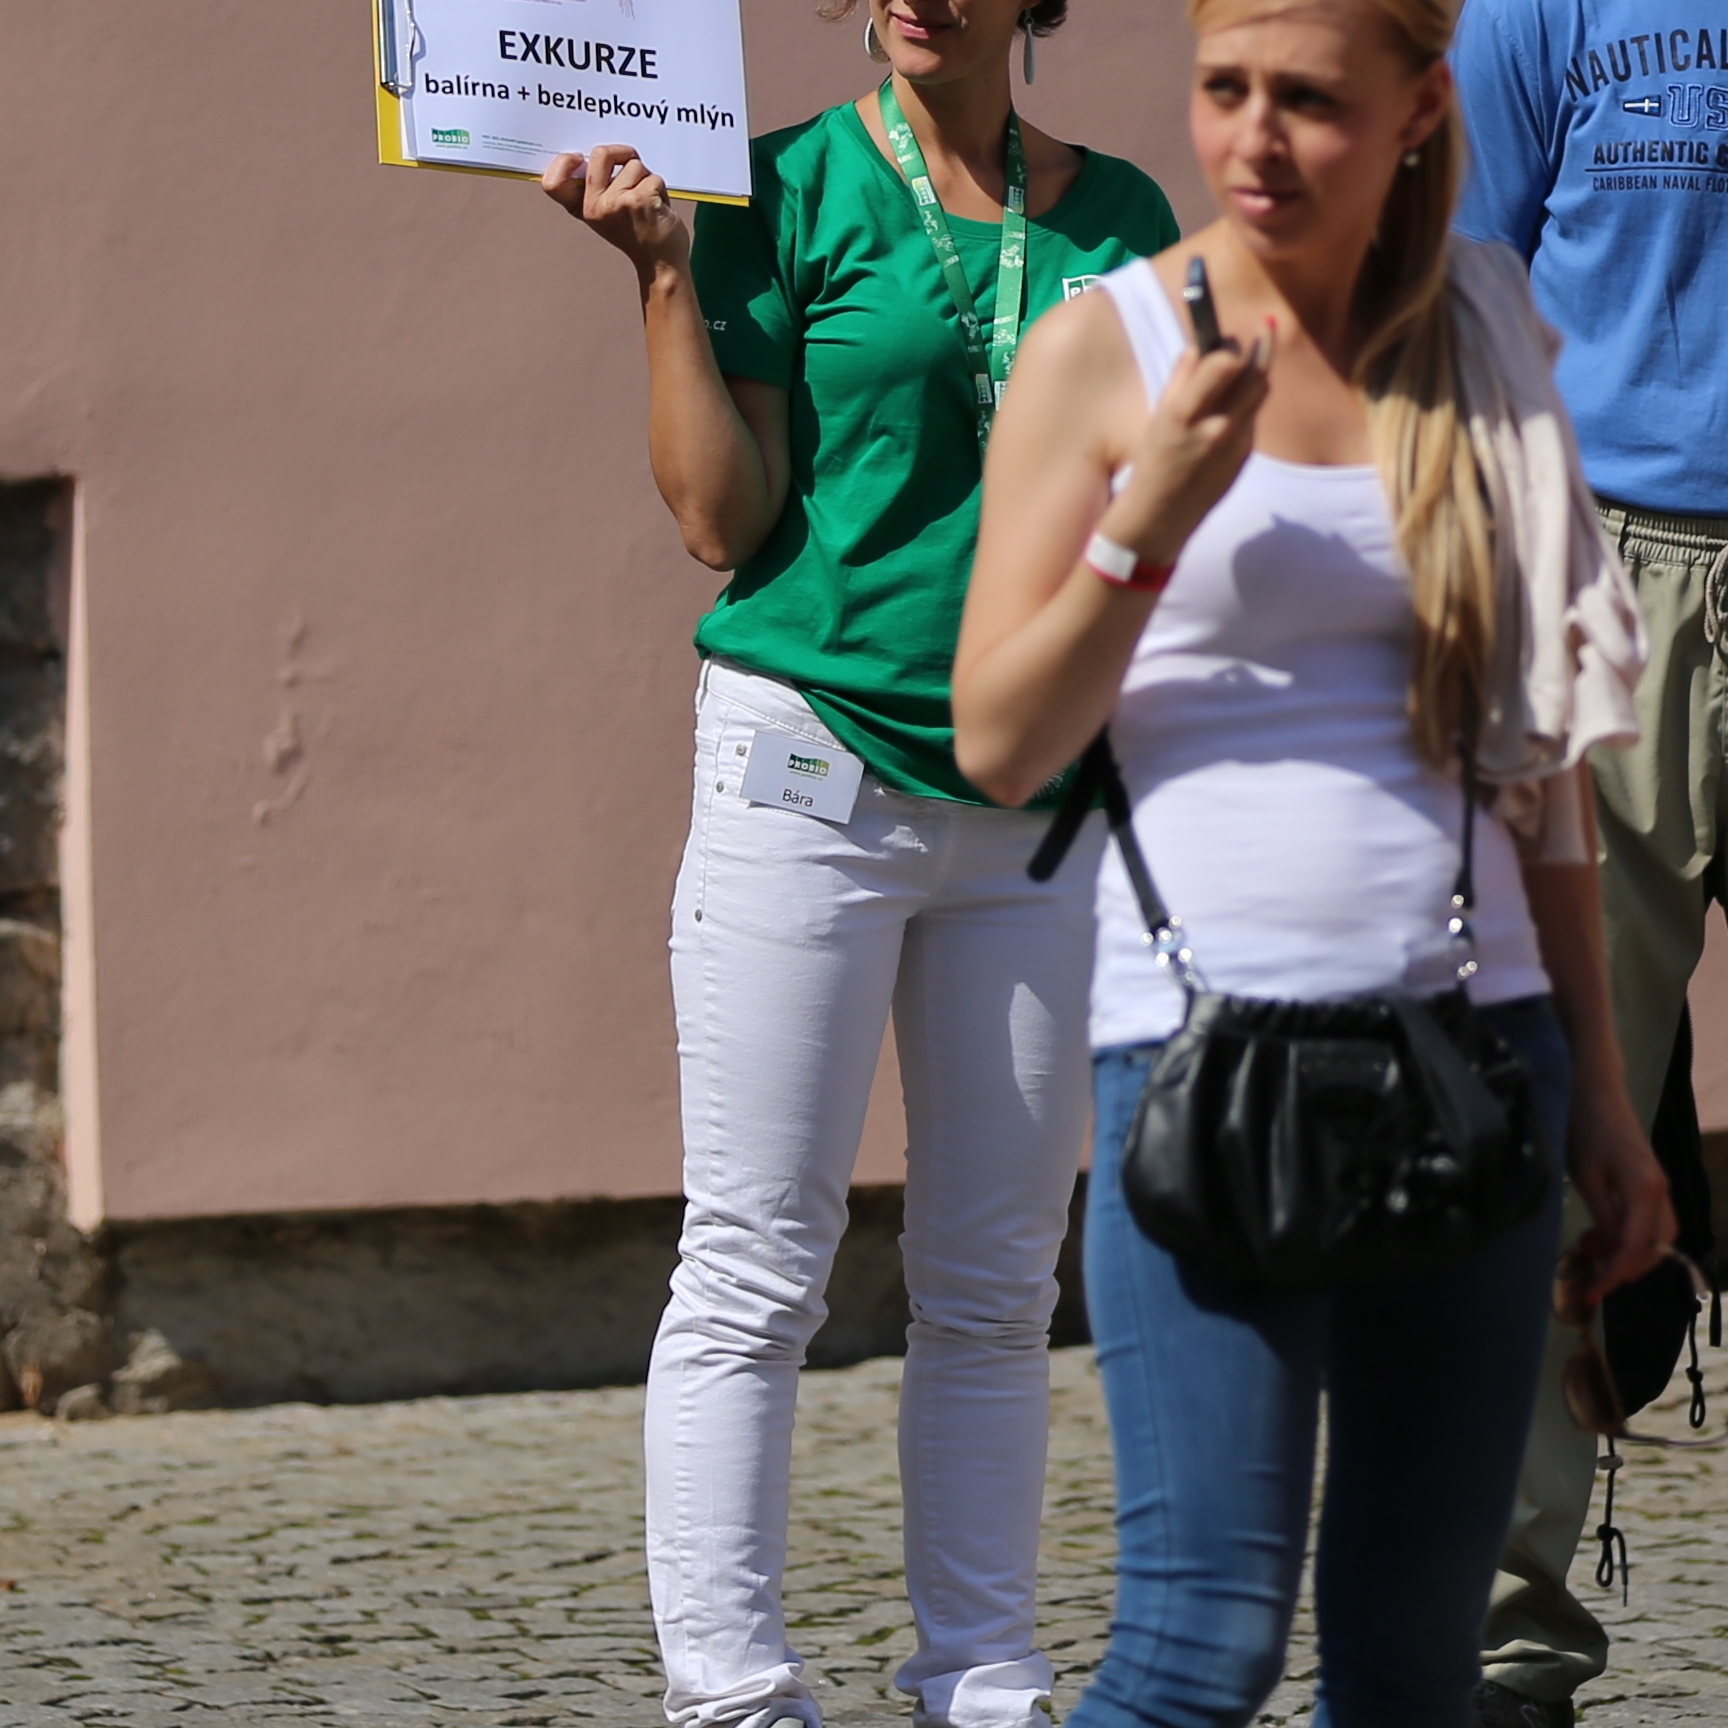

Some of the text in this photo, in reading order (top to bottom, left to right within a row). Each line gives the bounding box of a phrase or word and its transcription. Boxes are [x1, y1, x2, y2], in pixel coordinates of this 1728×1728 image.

[499, 29, 659, 80] EXKURZE
[424, 72, 735, 131] balírna + bezlepkový mlýn
[1593, 140, 1709, 167] AUTHENTIC
[1592, 175, 1658, 192] CARIBBEAN
[1663, 175, 1701, 192] NAVAL
[781, 788, 814, 808] Bára
